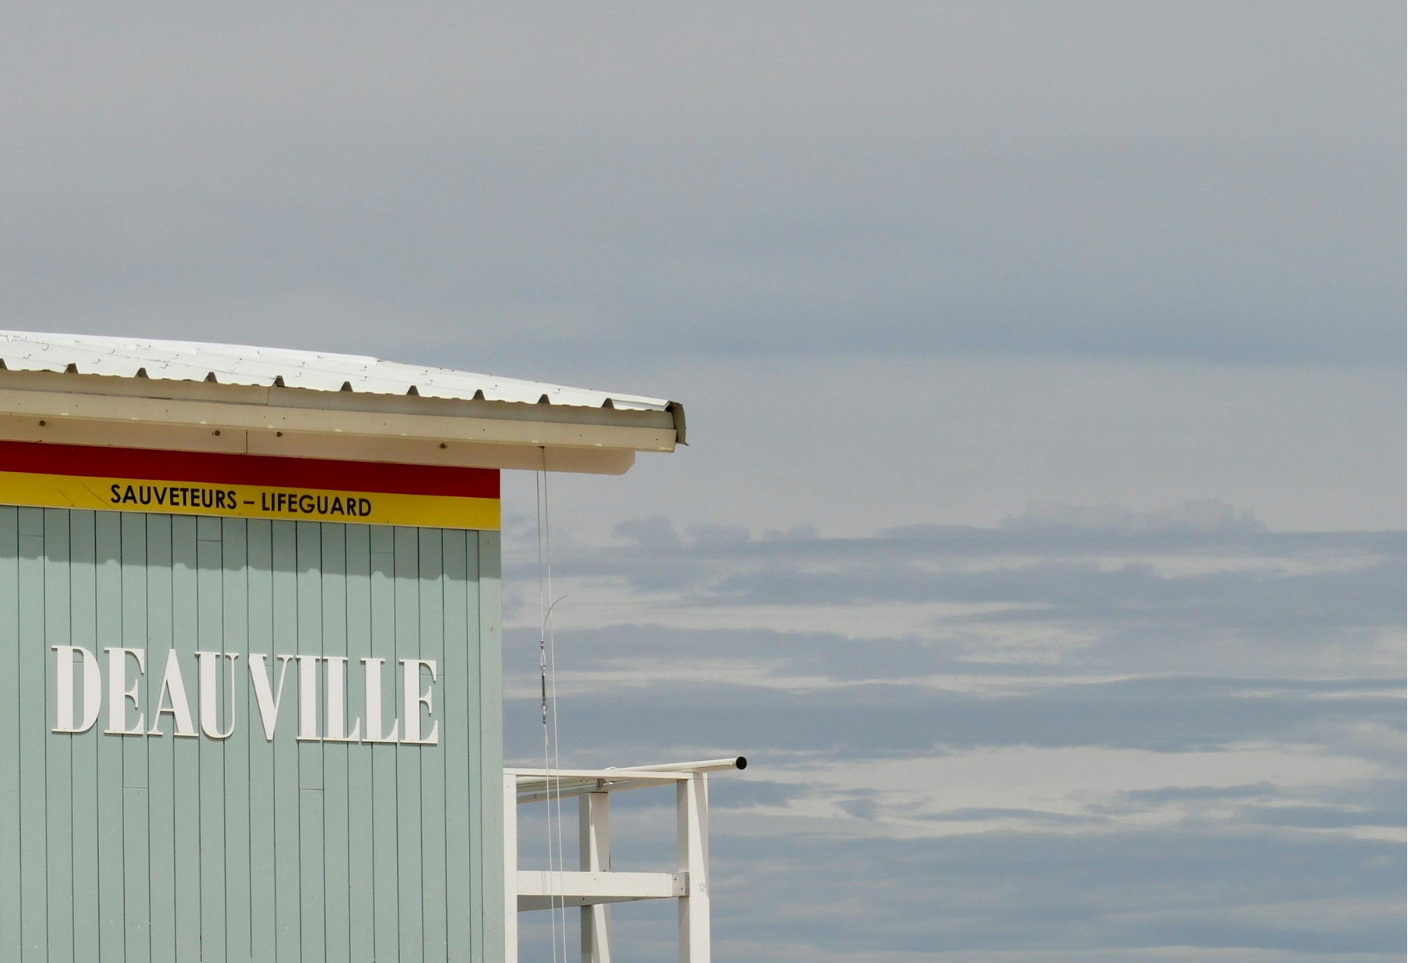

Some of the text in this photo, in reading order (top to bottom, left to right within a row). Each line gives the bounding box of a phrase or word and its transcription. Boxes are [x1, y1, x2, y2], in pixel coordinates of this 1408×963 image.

[110, 483, 237, 510] SAUVETEURS
[261, 492, 372, 517] LIFEGUARD
[51, 645, 439, 744] DEAUVILLE
